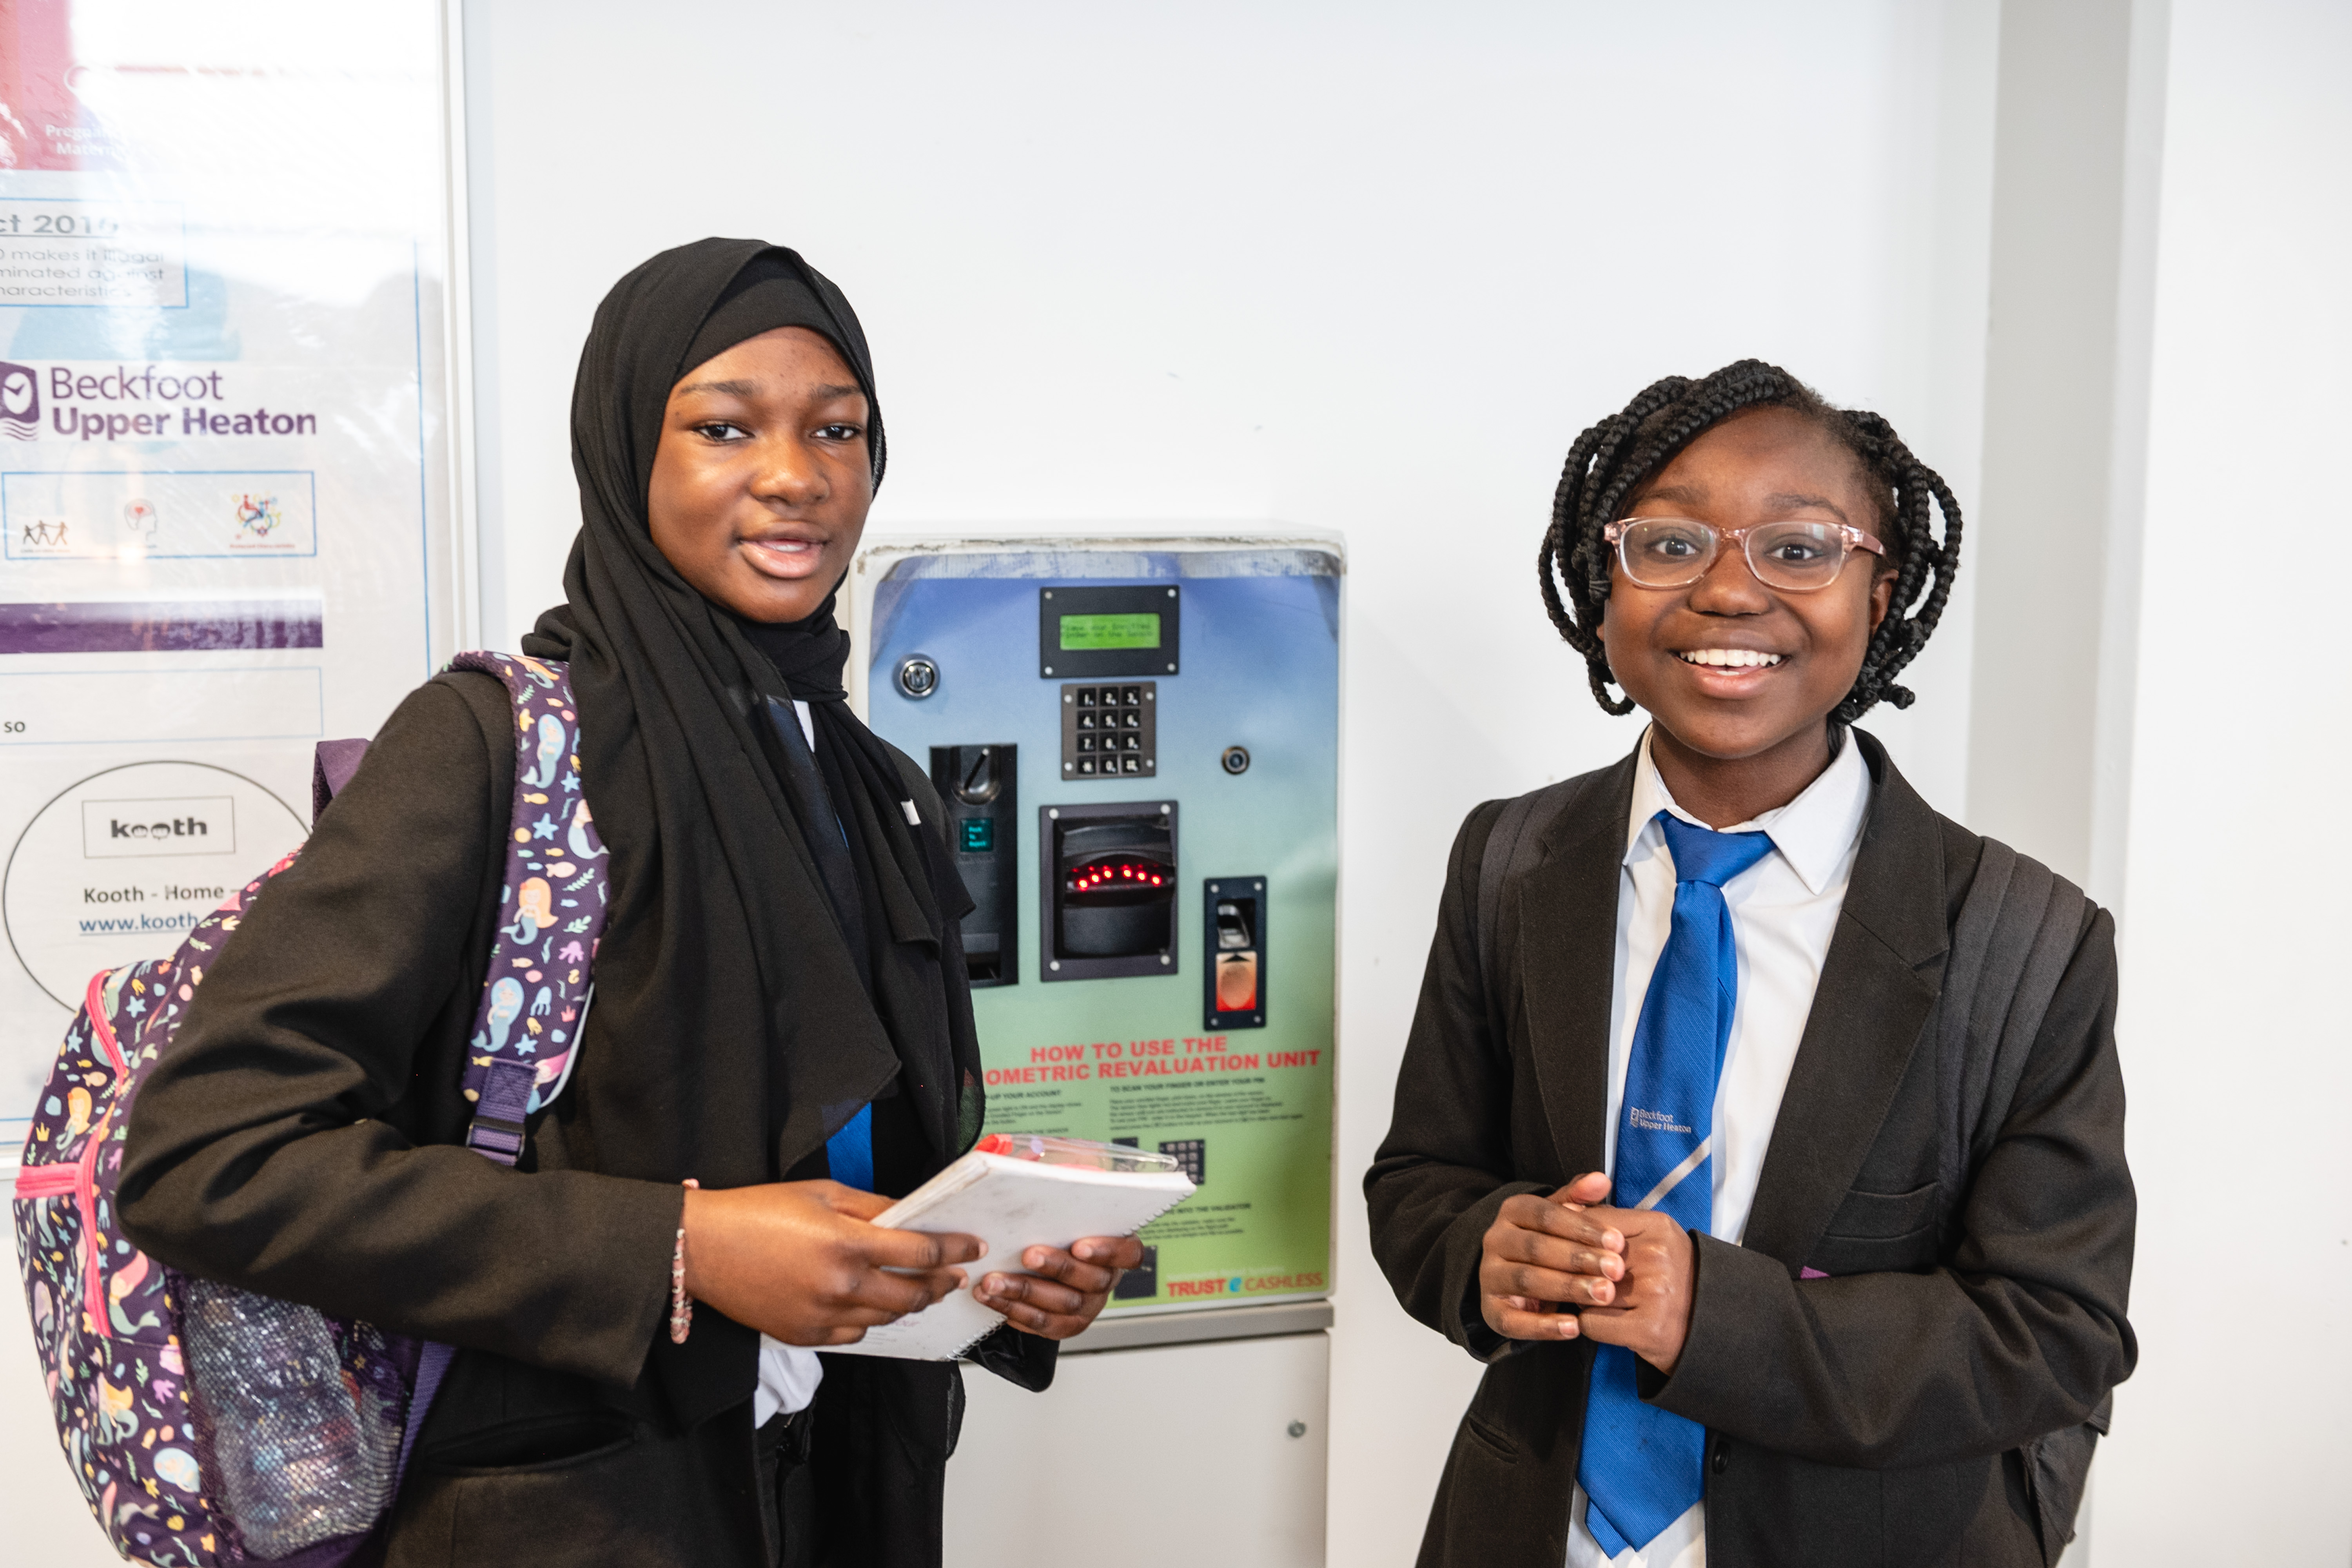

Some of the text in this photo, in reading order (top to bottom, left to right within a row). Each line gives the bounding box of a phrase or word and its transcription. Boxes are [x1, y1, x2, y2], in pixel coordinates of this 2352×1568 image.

[12, 249, 79, 261] makes
[86, 249, 97, 261] it
[51, 365, 223, 400] Beckfoot
[53, 407, 316, 441] Upper Heaton
[4, 721, 25, 733] so
[1083, 716, 1091, 727] 4
[111, 817, 207, 839] kooth
[84, 886, 144, 903] Kooth
[165, 885, 224, 900] Home
[1031, 1035, 1227, 1063] HOW TO USE THE
[984, 1049, 1321, 1086] OMETRIC REVALUATION UNIT
[1640, 1109, 1673, 1123] Beckfoot
[1640, 1118, 1692, 1133] Upper Heaton
[1166, 1278, 1227, 1297] TRUST
[1244, 1272, 1323, 1292] CASHLESS
